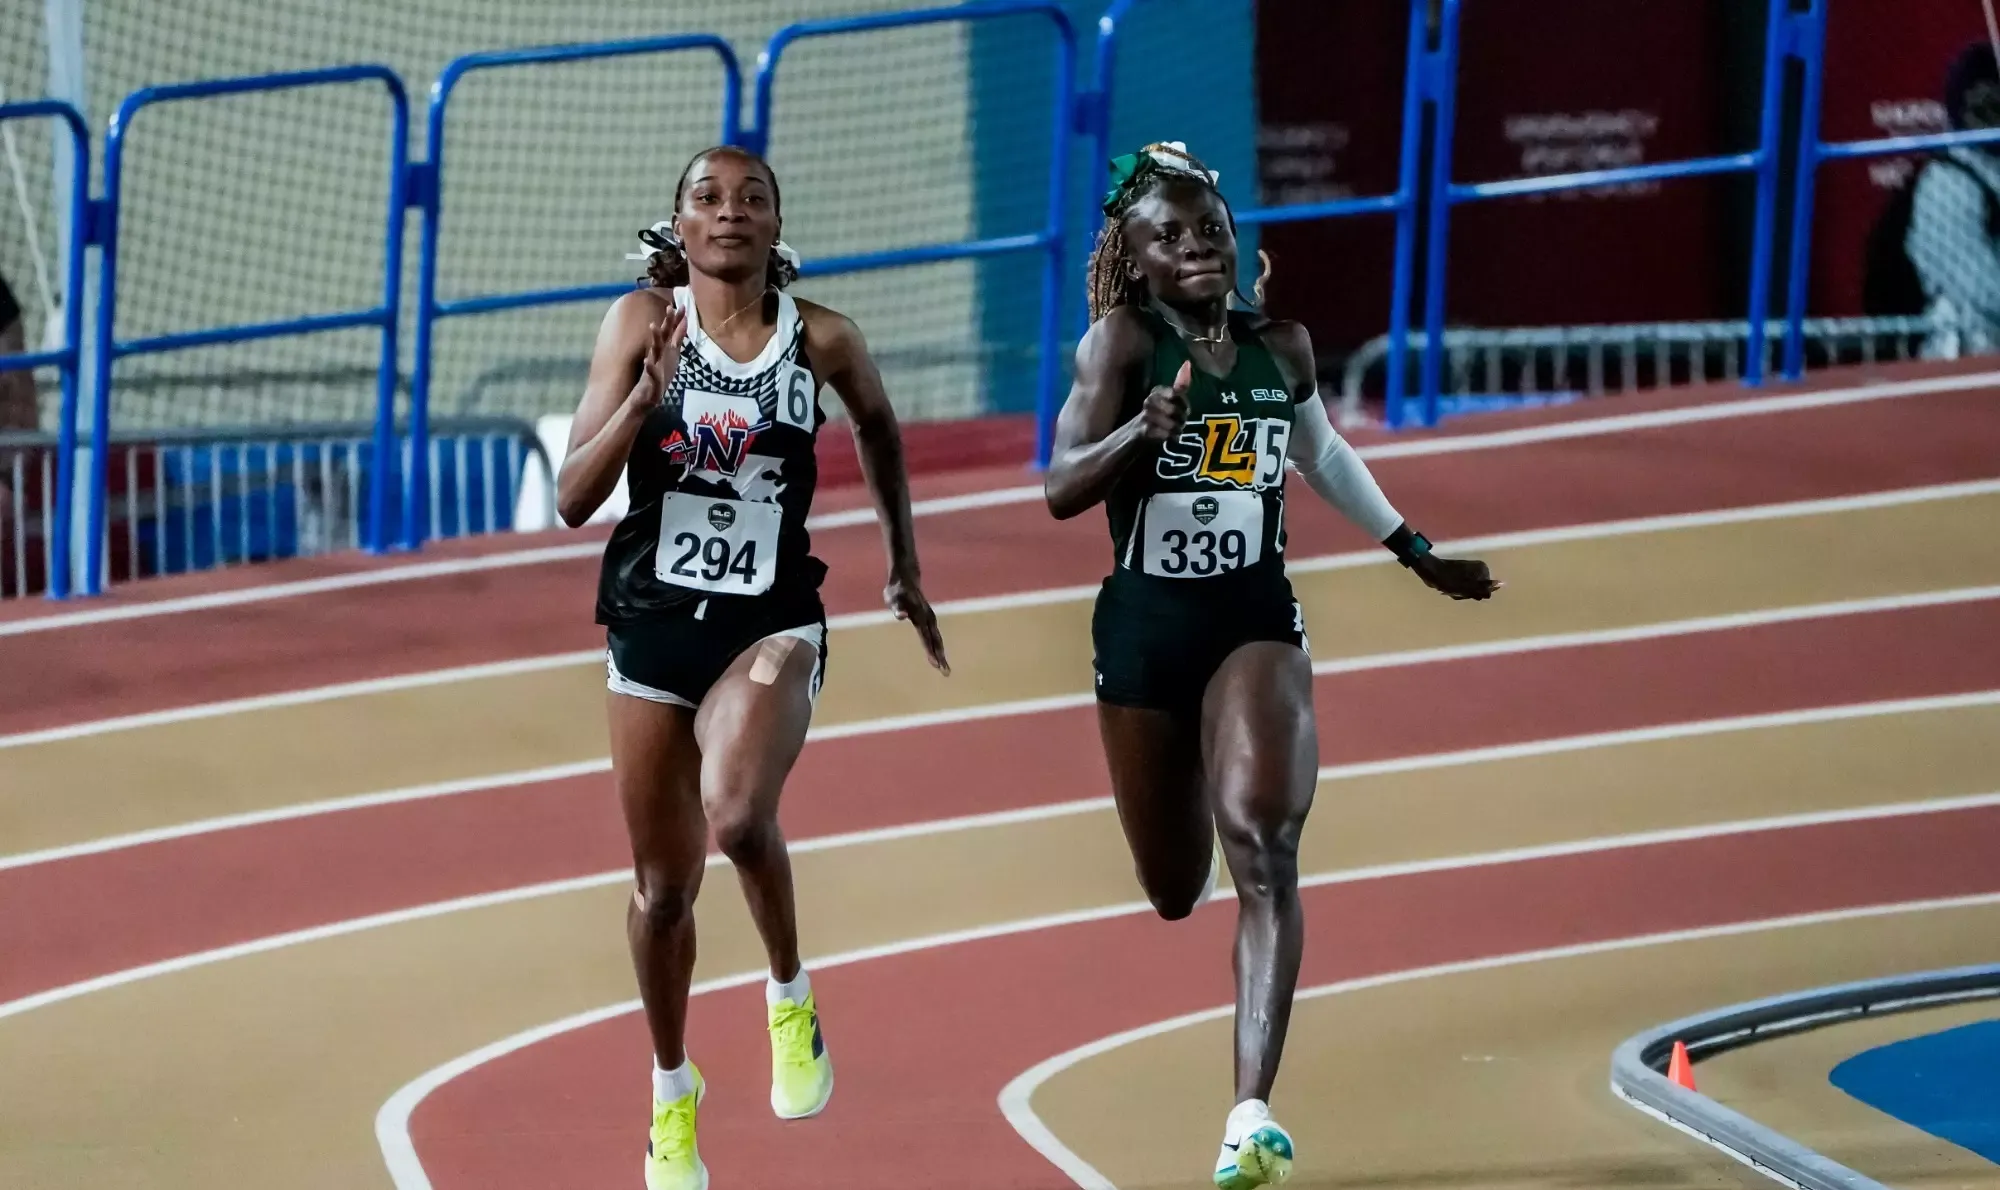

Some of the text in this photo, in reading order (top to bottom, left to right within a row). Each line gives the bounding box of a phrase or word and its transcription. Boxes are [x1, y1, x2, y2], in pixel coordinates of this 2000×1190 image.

[787, 369, 809, 425] 6
[1251, 388, 1288, 402] SLC
[693, 422, 749, 477] N
[1262, 424, 1286, 485] 5
[669, 531, 758, 585] 294
[1160, 529, 1247, 576] 339
